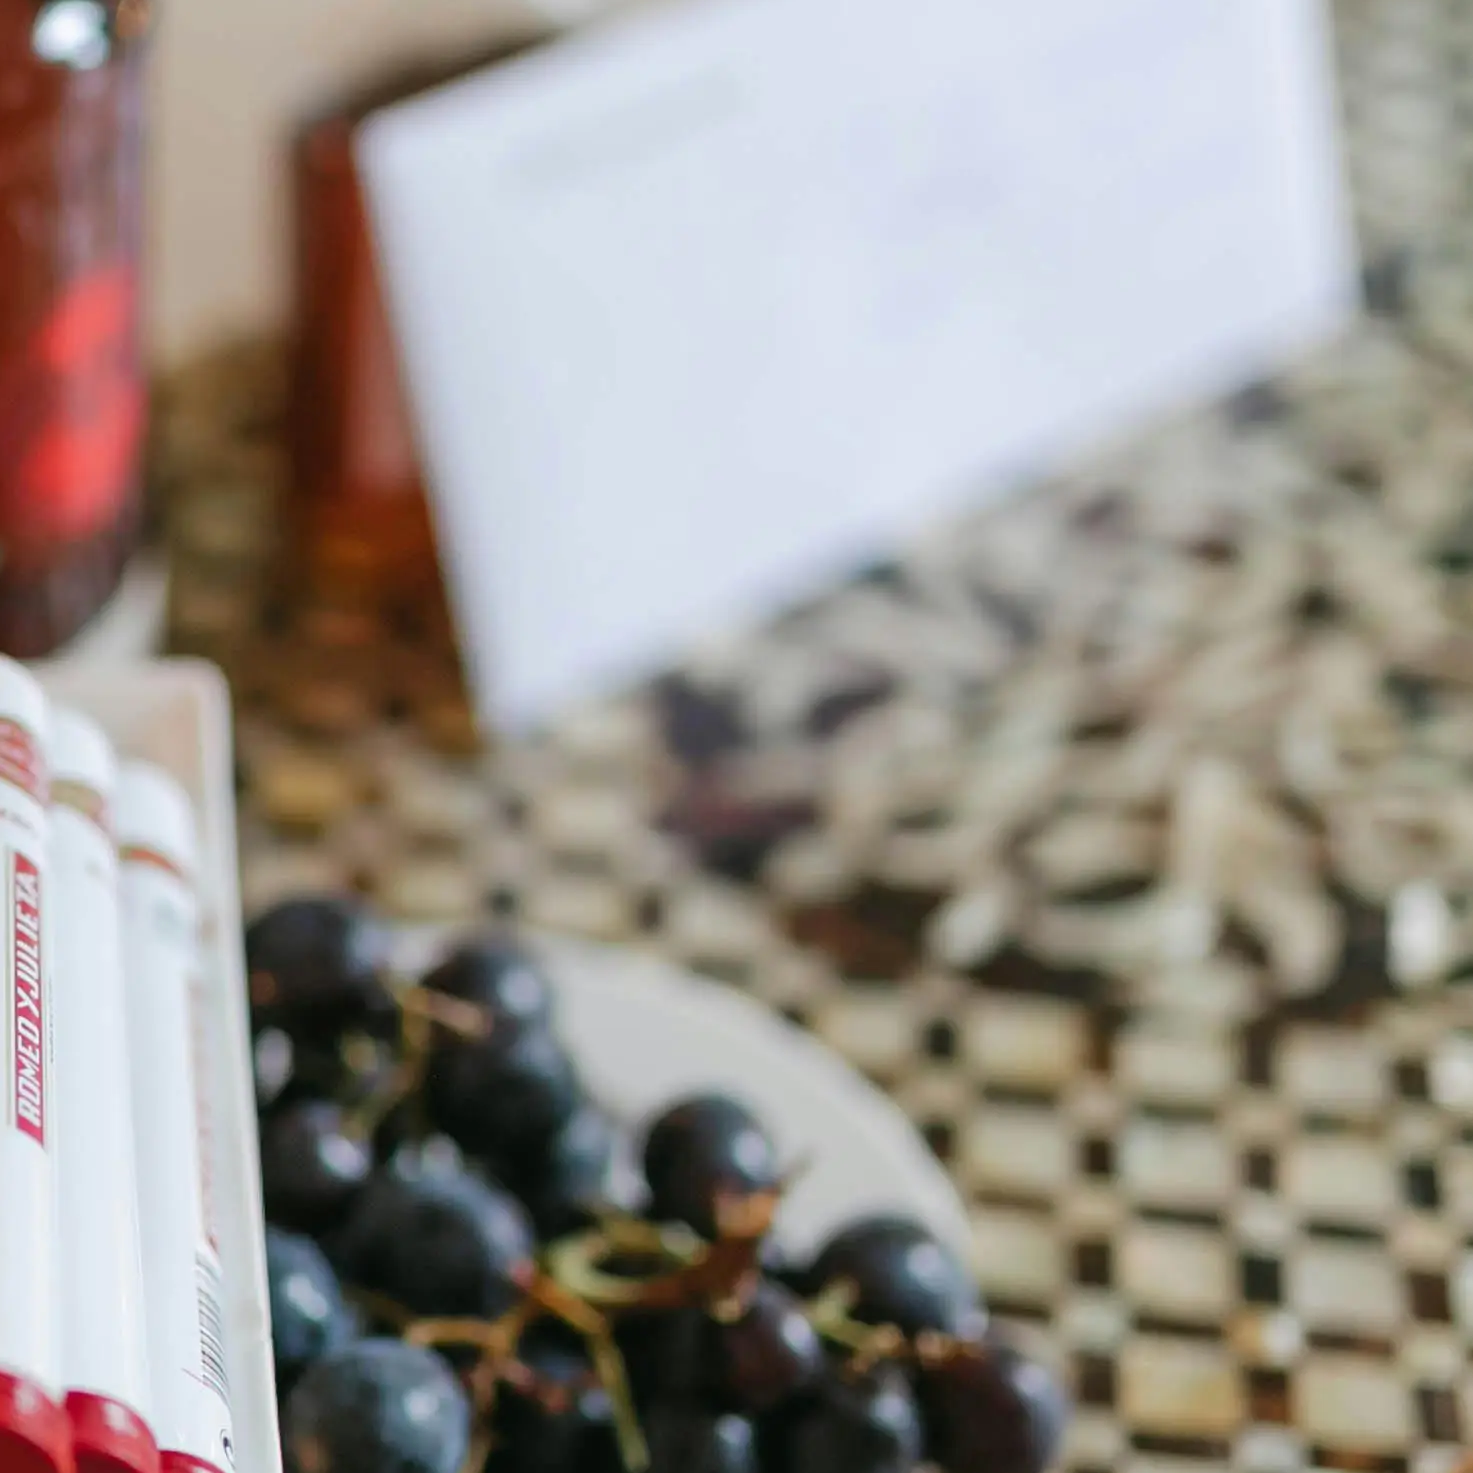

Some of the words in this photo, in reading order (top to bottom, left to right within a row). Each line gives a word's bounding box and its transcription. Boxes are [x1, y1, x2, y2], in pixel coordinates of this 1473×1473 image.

[16, 871, 40, 1001] JULIETA
[17, 987, 40, 1018] Y
[17, 1015, 41, 1128] ROMEO
